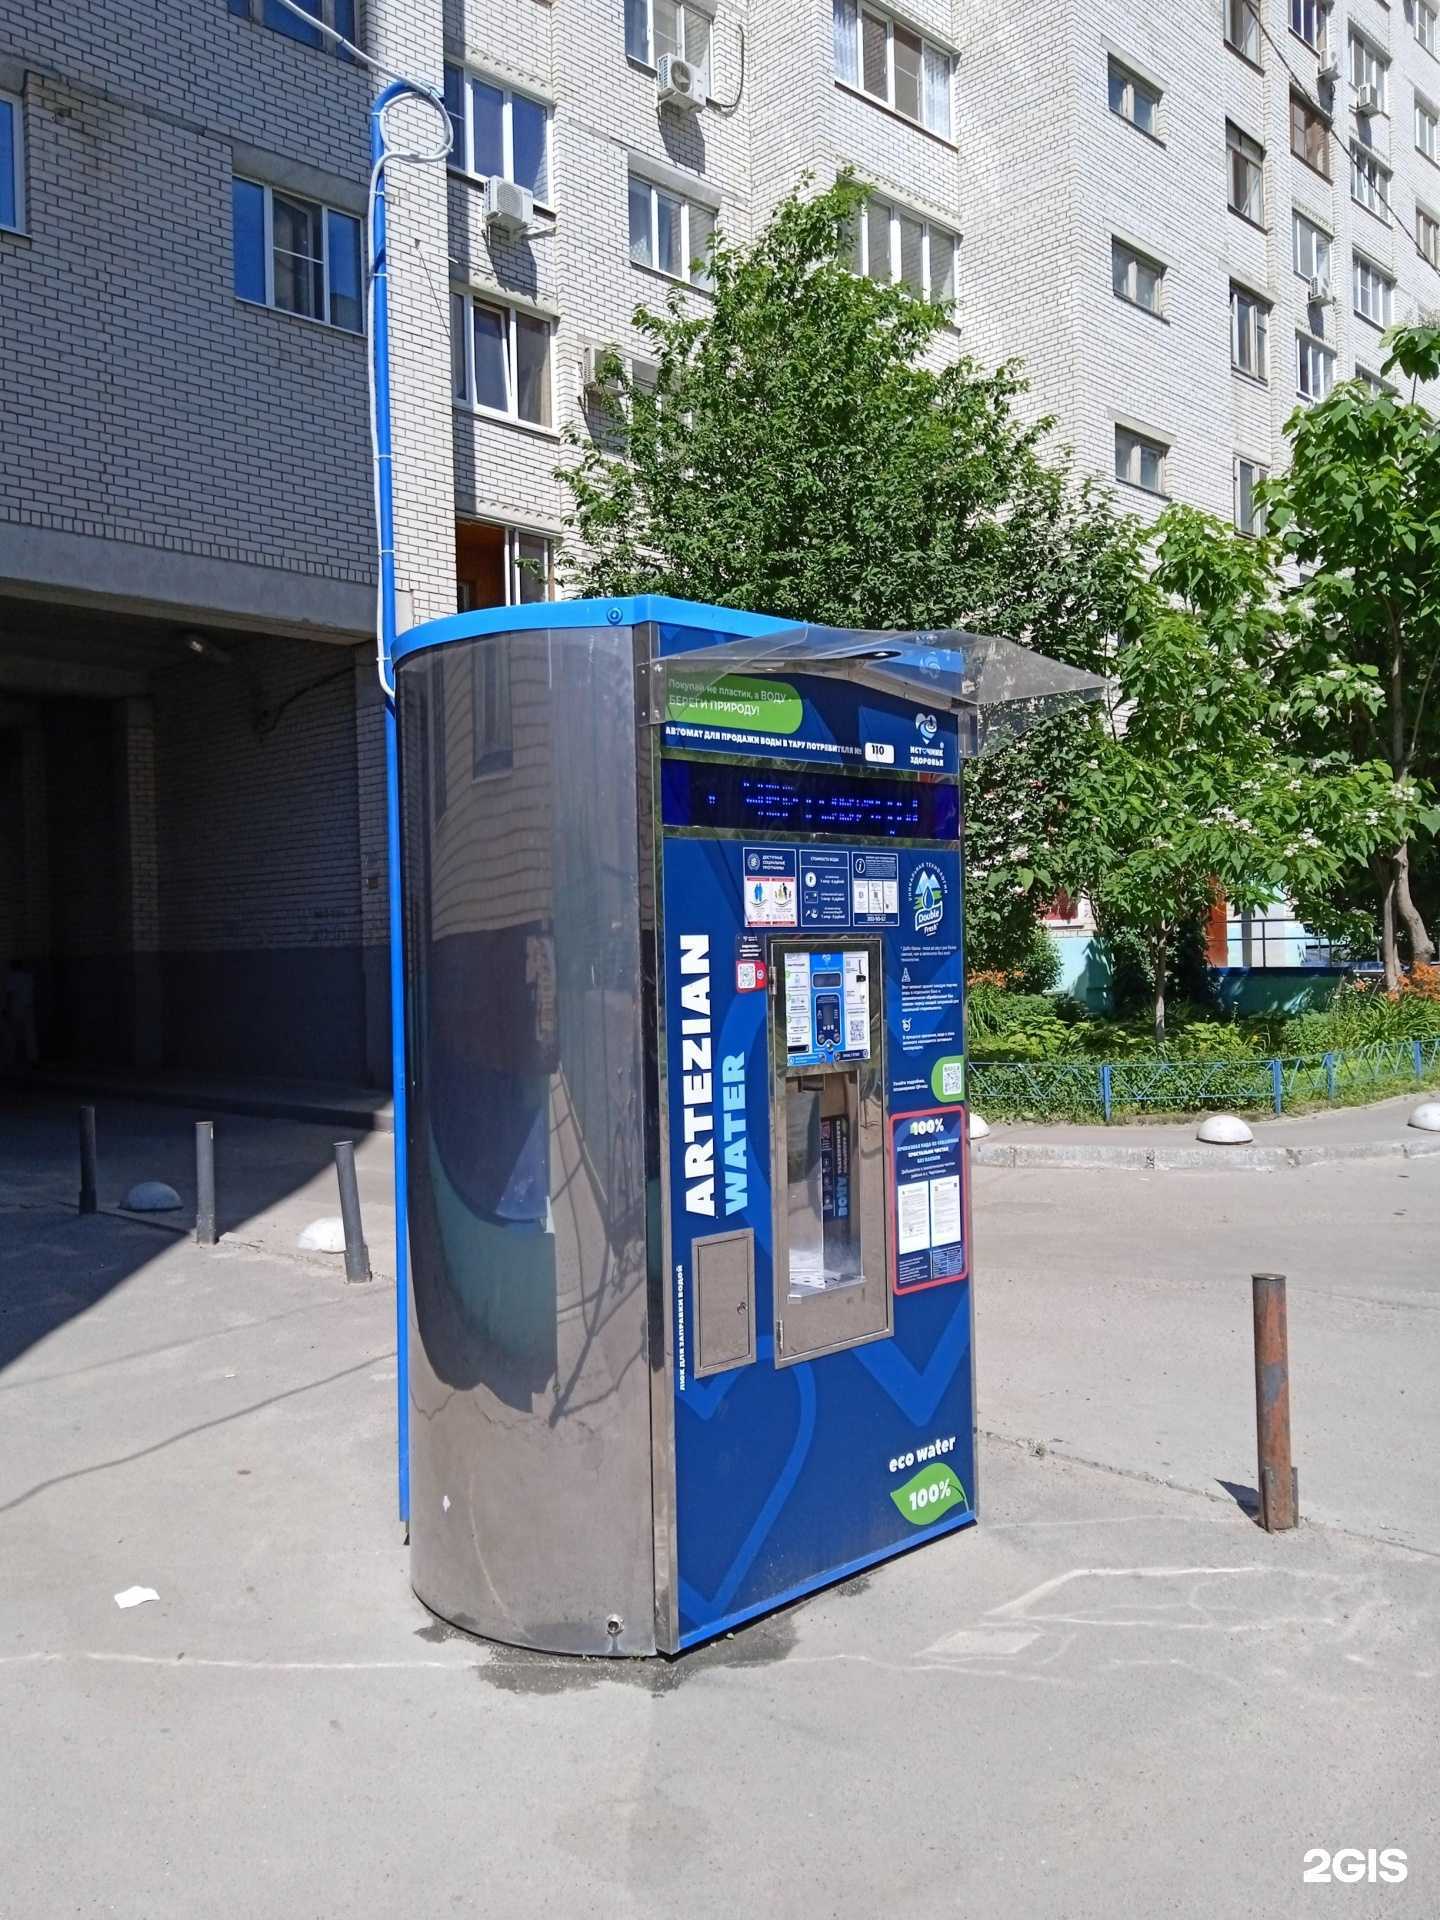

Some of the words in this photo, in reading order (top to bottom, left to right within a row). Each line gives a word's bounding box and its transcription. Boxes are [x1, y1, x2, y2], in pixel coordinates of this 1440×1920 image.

[706, 686, 717, 694] не
[669, 694, 708, 709] БЕРЕГИ
[710, 701, 760, 716] ПРИРОДУ!
[665, 726, 703, 738] АВТОМАТ
[704, 730, 721, 740] ДЛЯ
[721, 732, 760, 745] ПРОДАЖИ
[760, 737, 782, 747] ВОДЫ
[783, 739, 788, 747] В
[788, 740, 806, 750] ТАРУ
[806, 743, 854, 755] ПОТРЕБИТЕЛЯ
[871, 744, 885, 756] 110
[910, 756, 944, 767] ЗДОРОВЬЯ
[918, 909, 940, 923] Double
[680, 934, 715, 1216] ARTEZIAN
[722, 1051, 748, 1216] WATER
[676, 1264, 684, 1298] ВОДОЙ
[889, 1452, 915, 1473] eco
[916, 1436, 956, 1463] water
[909, 1478, 952, 1511] 100%
